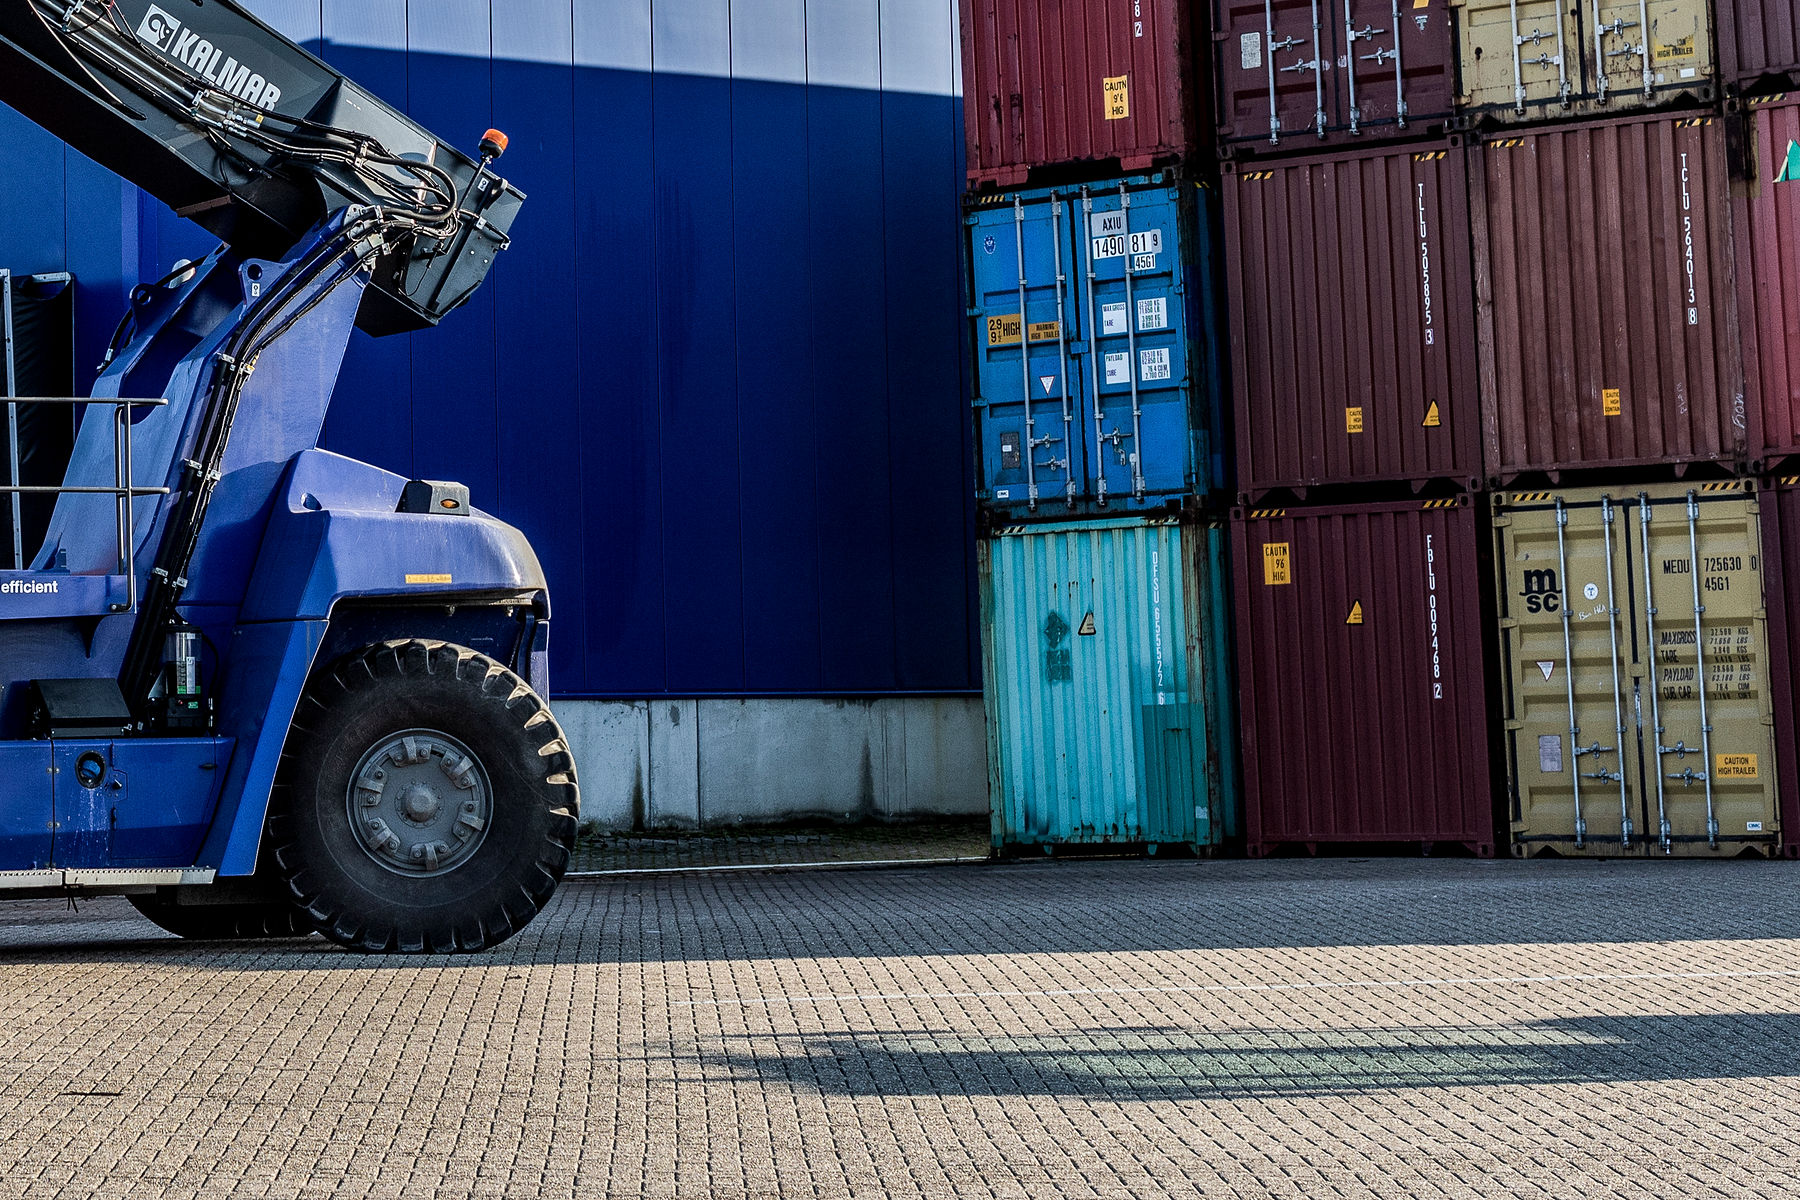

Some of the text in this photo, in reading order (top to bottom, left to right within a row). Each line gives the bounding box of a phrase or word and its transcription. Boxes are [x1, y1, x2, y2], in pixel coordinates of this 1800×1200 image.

[171, 27, 281, 112] KALMAR
[1681, 153, 1690, 211] TCLU
[1418, 183, 1427, 238] TLLU
[1103, 217, 1121, 231] AXIU
[1135, 255, 1155, 269] 45G1
[1684, 216, 1696, 304] 564013
[1422, 243, 1432, 324] 505895
[1003, 322, 1021, 336] HIGH
[1427, 535, 1436, 590] FBLU
[1663, 560, 1689, 574] MEDU
[1704, 556, 1741, 572] 725630
[1, 580, 58, 593] efficient
[1152, 551, 1160, 604] DFSU
[1704, 576, 1729, 591] 45G1
[1429, 594, 1440, 679] 009468
[1661, 649, 1679, 663] TARE
[1663, 667, 1694, 681] PAYLOAD
[1724, 757, 1749, 765] CAUTION
